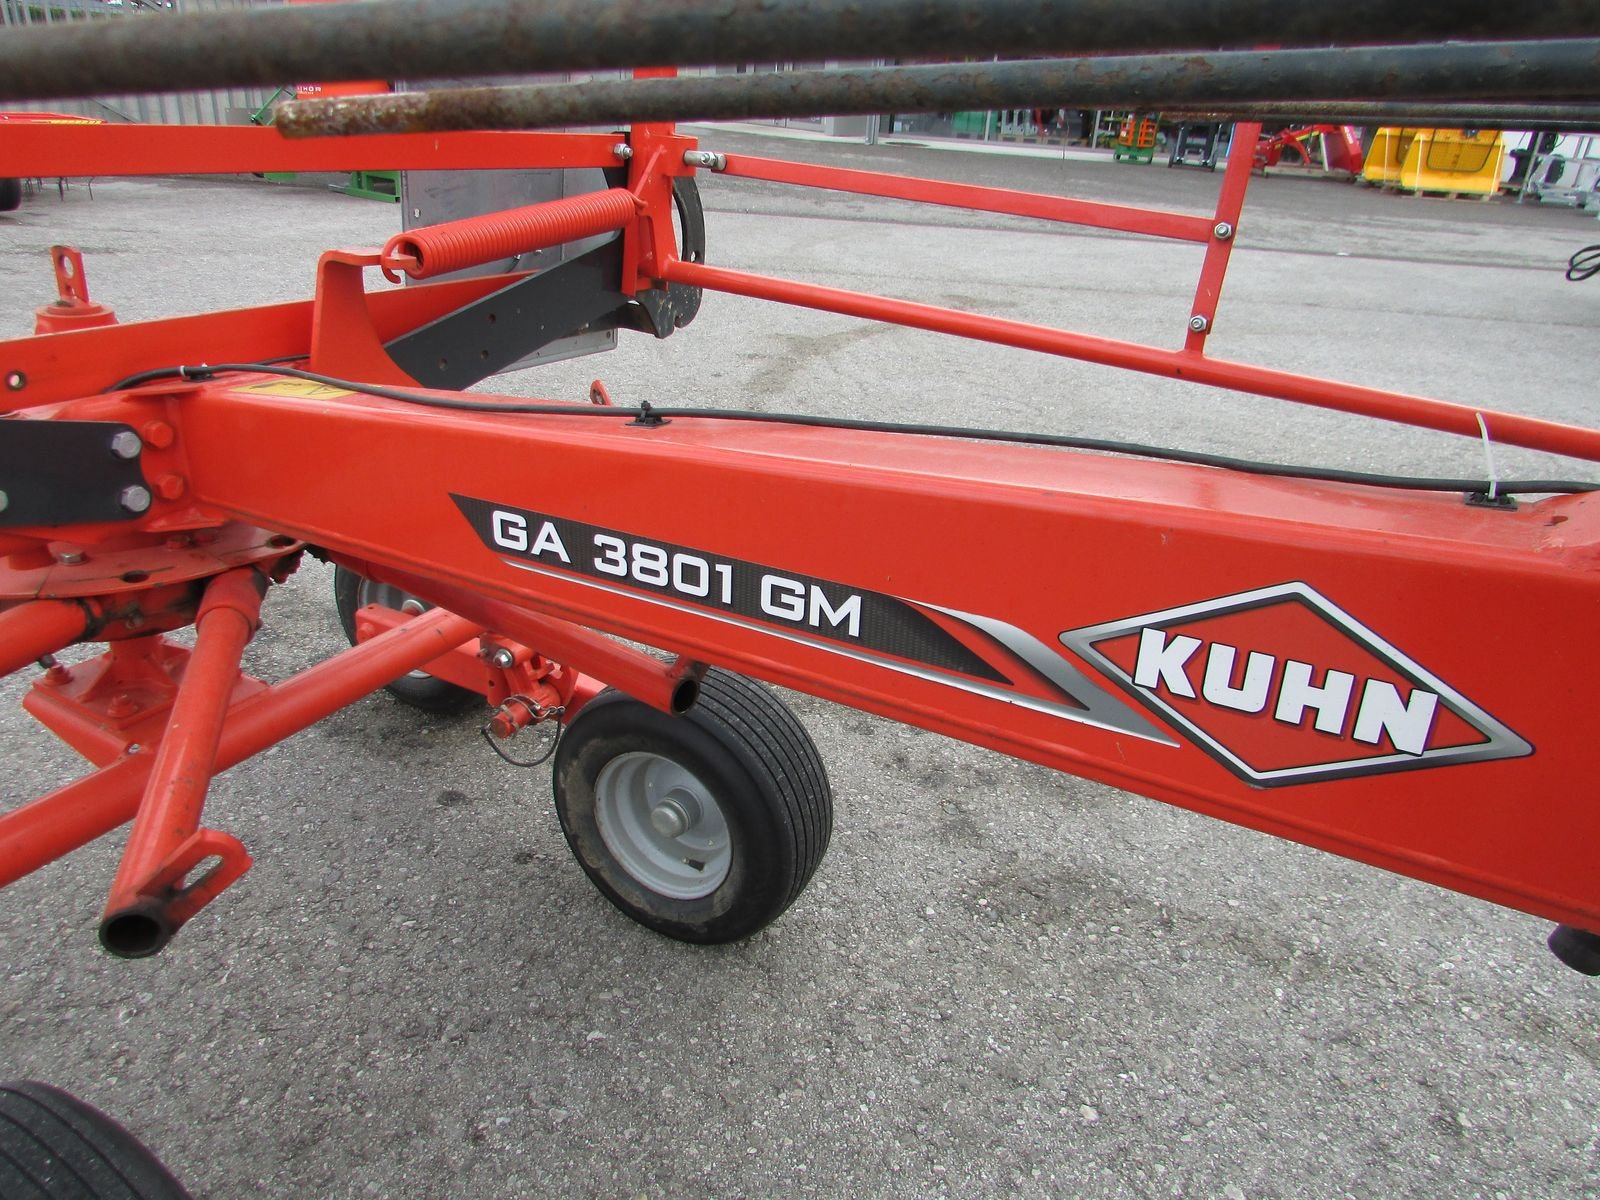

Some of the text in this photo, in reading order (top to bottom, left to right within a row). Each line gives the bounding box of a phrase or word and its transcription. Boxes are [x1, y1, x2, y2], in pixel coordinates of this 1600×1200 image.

[492, 510, 862, 638] GA 3801 GM
[1133, 627, 1440, 755] KUHN
